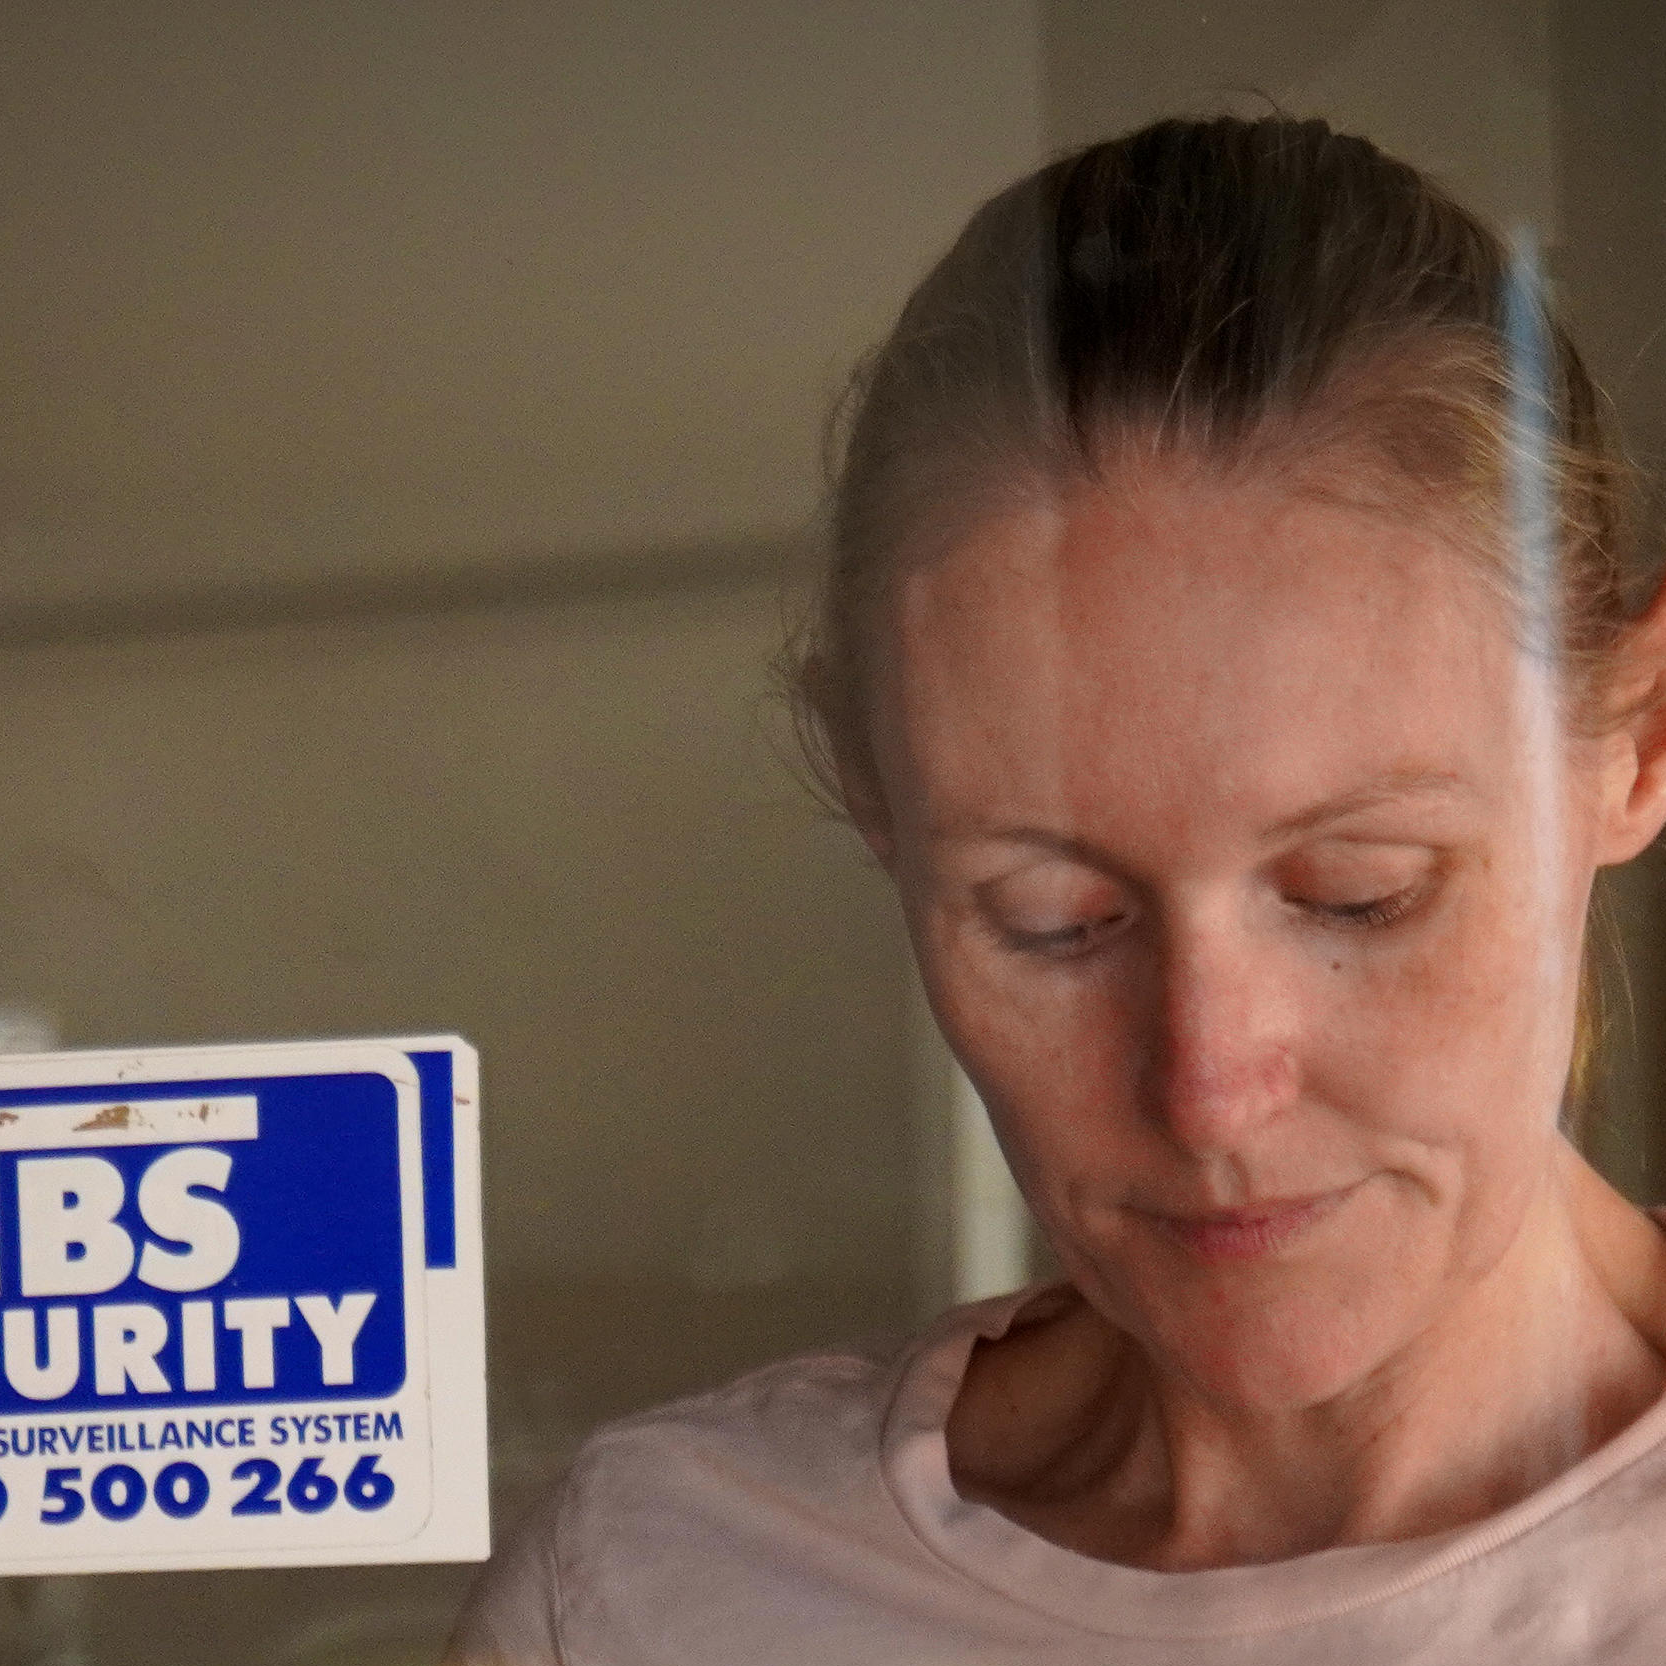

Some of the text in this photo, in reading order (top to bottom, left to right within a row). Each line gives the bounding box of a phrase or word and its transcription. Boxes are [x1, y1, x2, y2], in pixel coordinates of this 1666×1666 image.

[270, 1411, 405, 1448] SYSTEM
[39, 1460, 211, 1525] 500
[231, 1454, 396, 1517] 266
